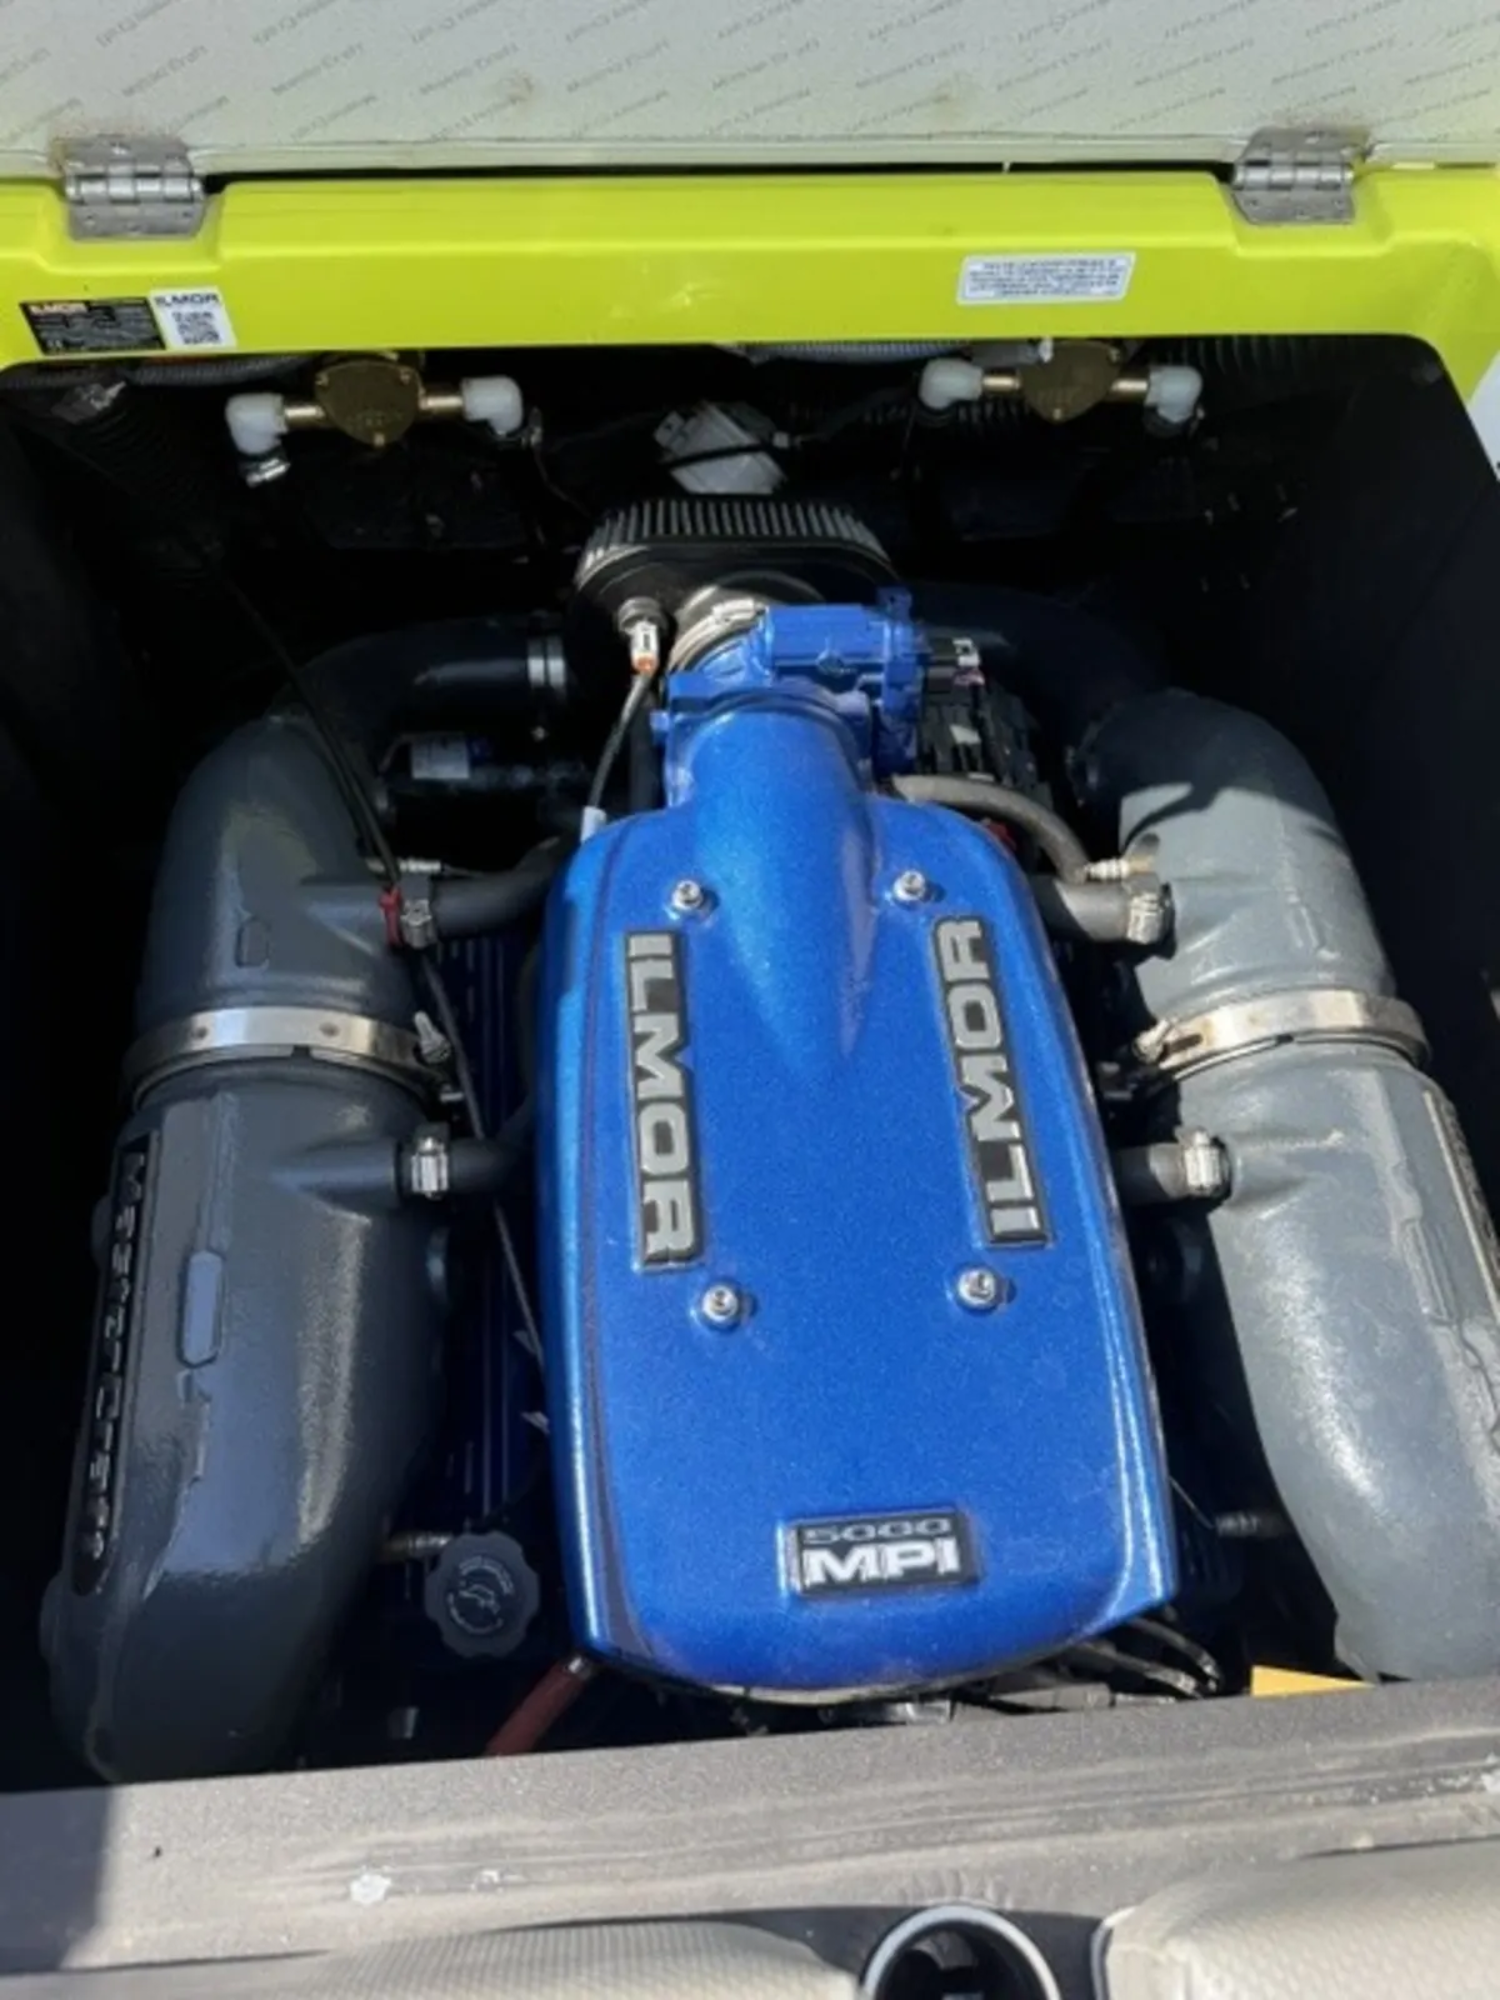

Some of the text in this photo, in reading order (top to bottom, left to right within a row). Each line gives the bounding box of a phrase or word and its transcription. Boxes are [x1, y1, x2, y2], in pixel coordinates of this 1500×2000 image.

[628, 933, 695, 1261] ILMOR
[937, 920, 1042, 1236] ILMOR
[802, 1536, 961, 1589] MPI
[803, 1517, 952, 1545] 5000
